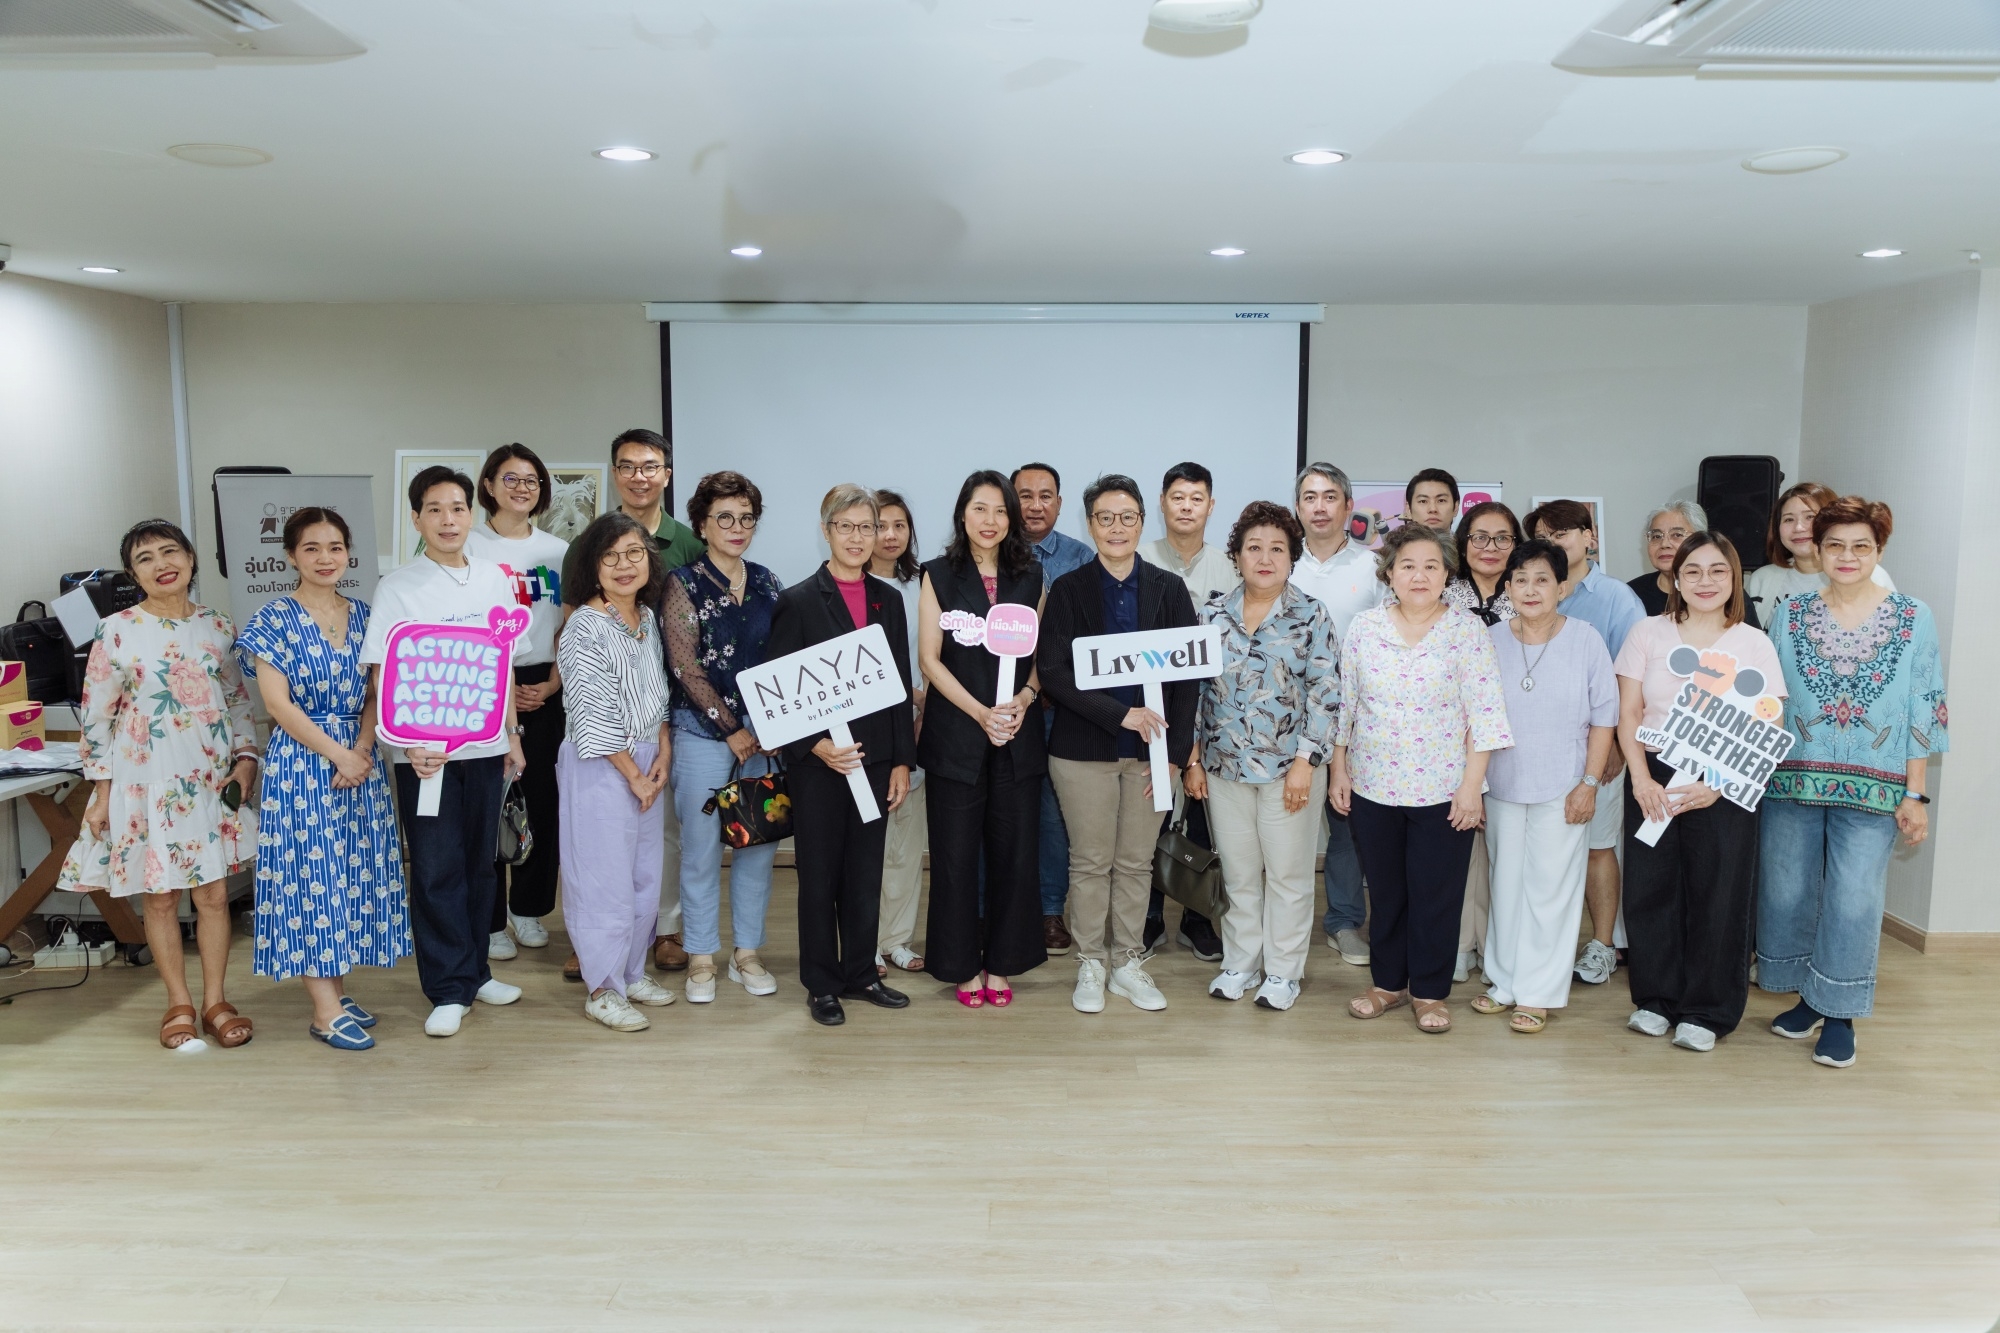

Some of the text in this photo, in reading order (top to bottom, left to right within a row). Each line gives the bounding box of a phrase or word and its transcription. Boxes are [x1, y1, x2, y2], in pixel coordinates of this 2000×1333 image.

[245, 556, 287, 579] อุ่นใจ
[941, 614, 984, 629] Smile
[990, 618, 1033, 633] เมืองไทย
[396, 636, 502, 668] ACTIVE
[397, 661, 496, 690] LIVING
[754, 643, 882, 707] NAYA
[393, 682, 498, 712] ACTIVE
[765, 669, 886, 721] RESIDENCE
[393, 704, 486, 733] AGING
[808, 713, 817, 721] by
[1677, 682, 1793, 761] STRONGER
[1637, 728, 1670, 747] WITH
[1663, 707, 1774, 785] TOGETHER
